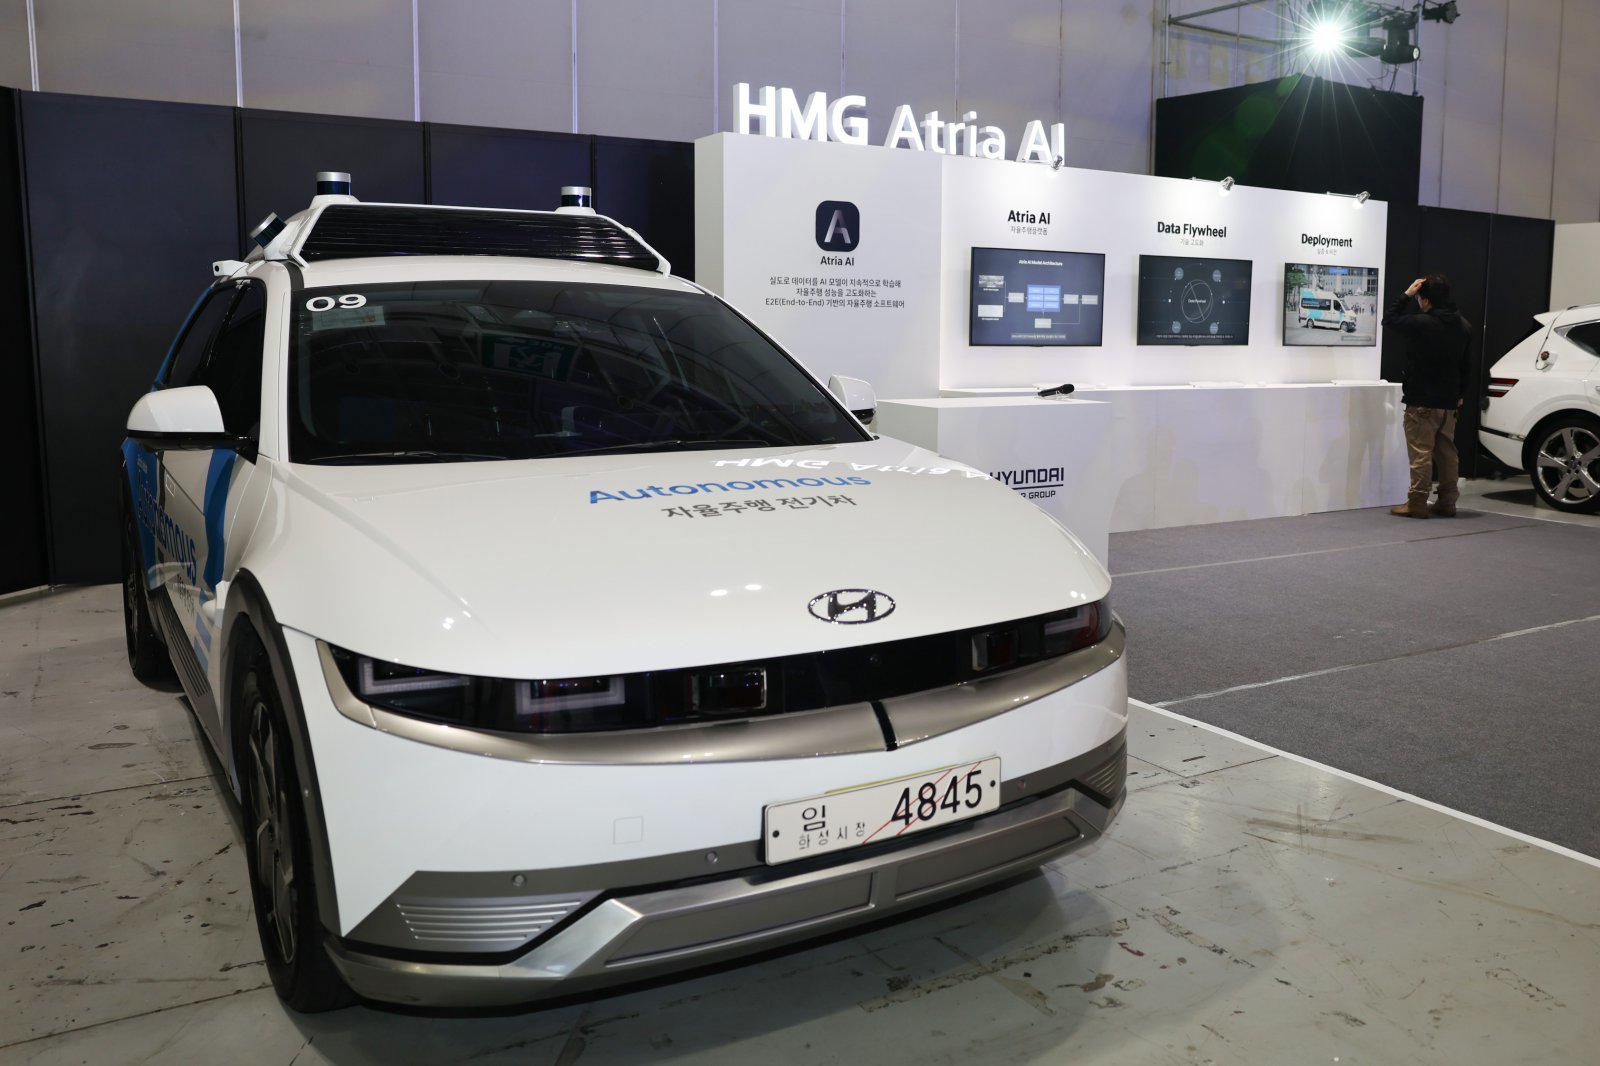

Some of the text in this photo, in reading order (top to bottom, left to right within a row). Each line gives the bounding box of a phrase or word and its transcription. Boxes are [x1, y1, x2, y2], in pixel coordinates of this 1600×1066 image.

[733, 82, 1065, 166] HMG Atria AI
[1007, 210, 1051, 225] Atria AI
[1157, 221, 1227, 238] Data Flywheel
[1301, 233, 1353, 248] Deployment
[820, 256, 855, 266] Atria AI
[769, 276, 902, 289] 실도로 데이터를 AI 모델이 지속적으로 학습해
[796, 287, 877, 298] 자율주행 성능을 고도화하는
[305, 293, 367, 312] 09
[765, 298, 905, 309] E2E(End-to-End) 기반의 자율주행 소프트웨어
[589, 475, 872, 504] Autonomous
[1028, 490, 1056, 499] GROUP
[661, 494, 857, 519] 자율주행 전기차
[801, 769, 983, 832] 임 4845
